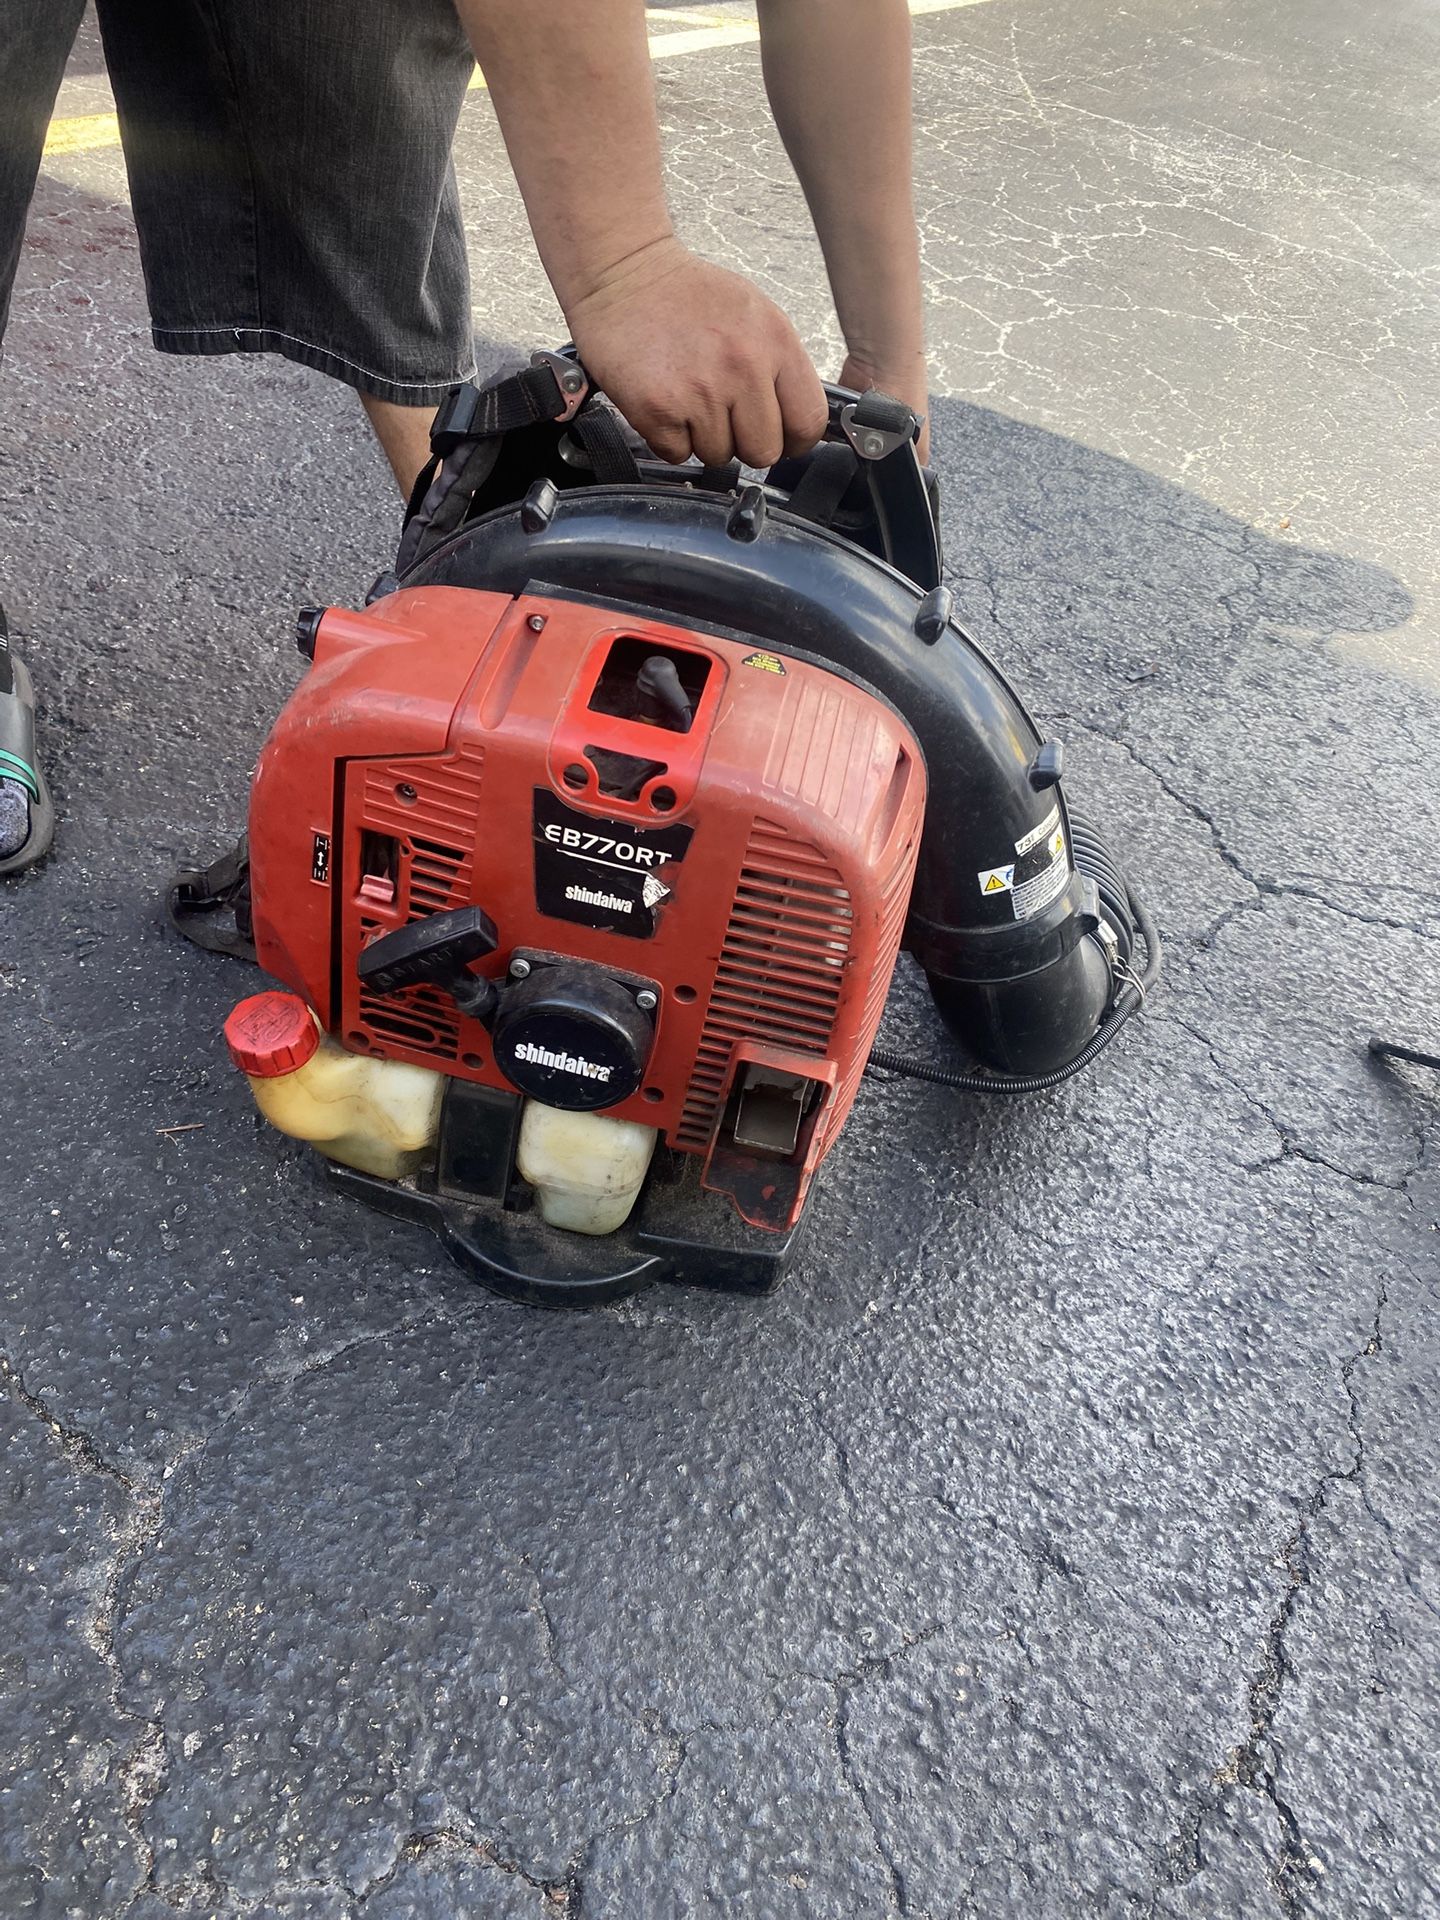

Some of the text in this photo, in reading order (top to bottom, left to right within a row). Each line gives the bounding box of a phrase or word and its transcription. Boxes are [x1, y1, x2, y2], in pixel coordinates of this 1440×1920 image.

[544, 823, 673, 867] EB770RT
[564, 884, 634, 914] shindaiwa
[514, 1042, 612, 1083] shindaiwa
